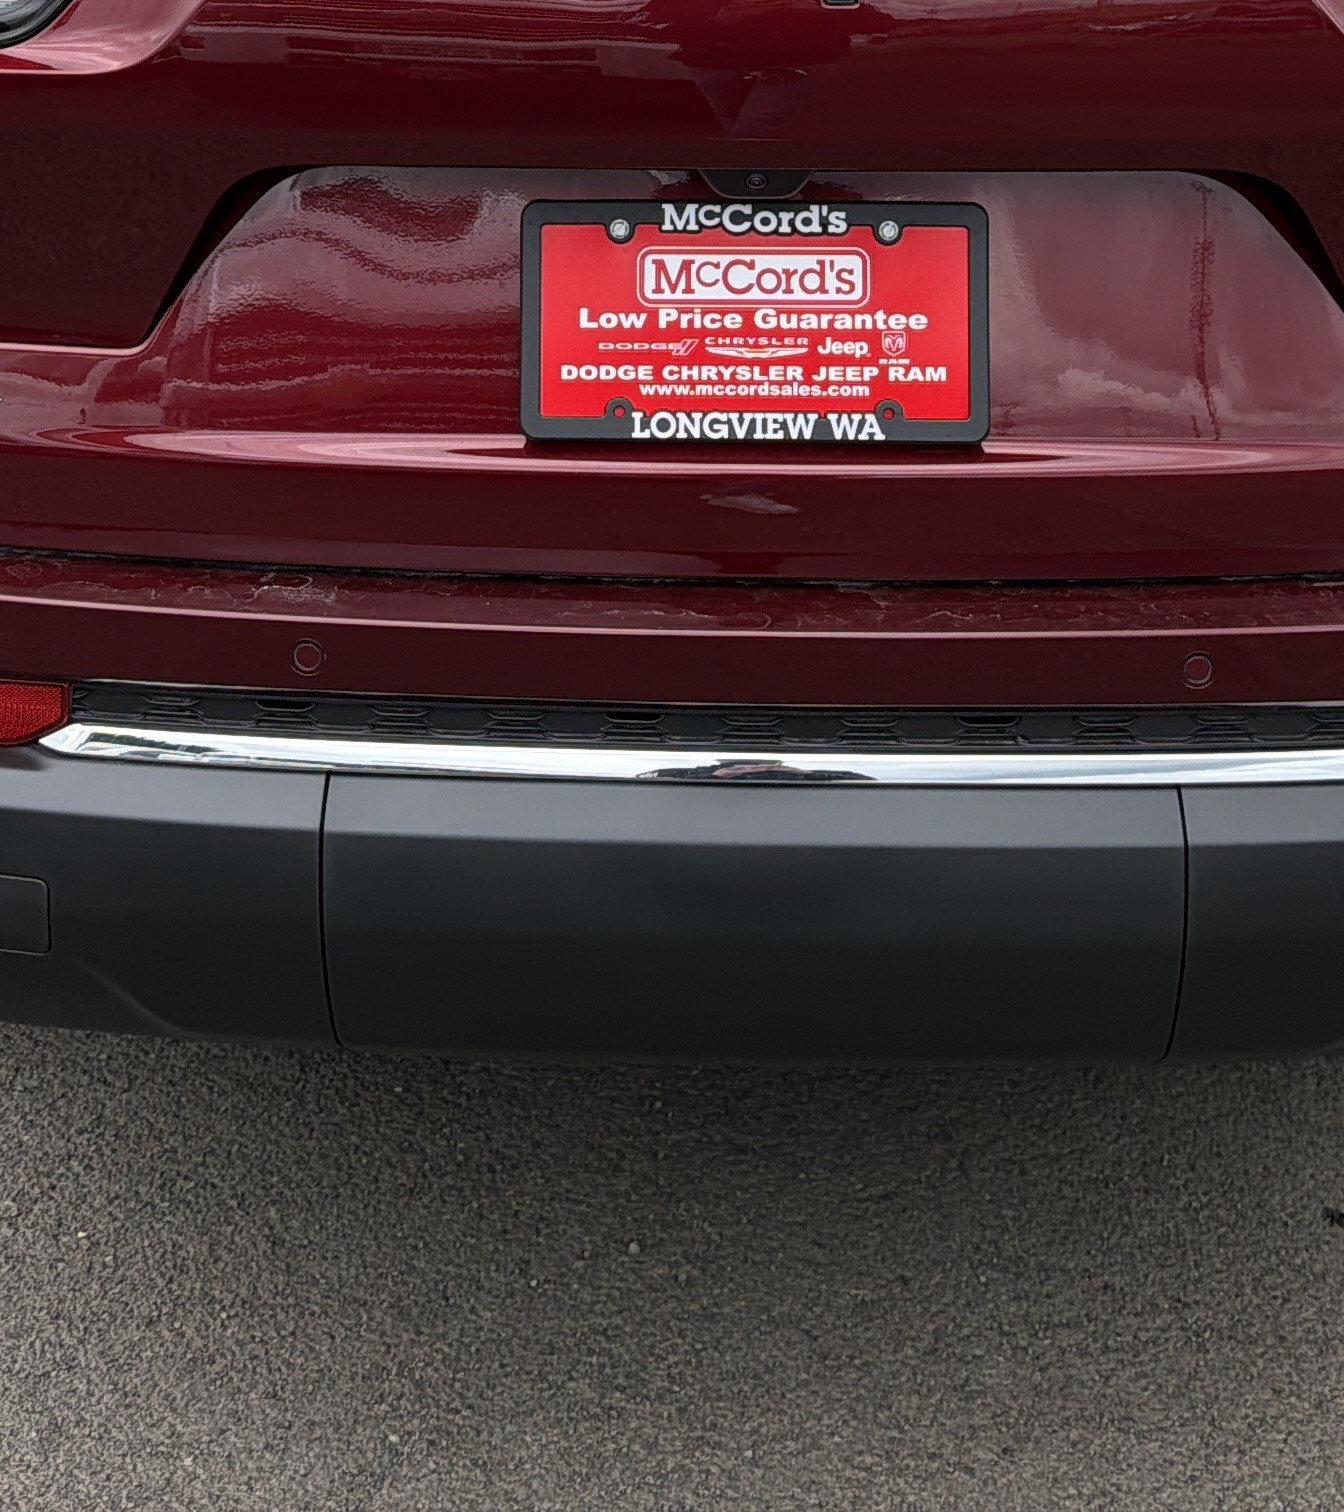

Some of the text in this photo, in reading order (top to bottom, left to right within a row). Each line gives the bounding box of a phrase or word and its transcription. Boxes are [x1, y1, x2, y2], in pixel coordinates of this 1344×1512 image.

[661, 203, 848, 233] McCord's
[651, 258, 856, 295] McCord's
[579, 308, 928, 330] Low Price Guarantee
[704, 336, 809, 346] CHRYSLER
[816, 336, 869, 358] Jeep
[561, 365, 947, 381] DODGE CHRYSLER JEEP RAM
[639, 382, 870, 397] www.mccordsales.com
[631, 411, 886, 440] LONGVIEW WA
